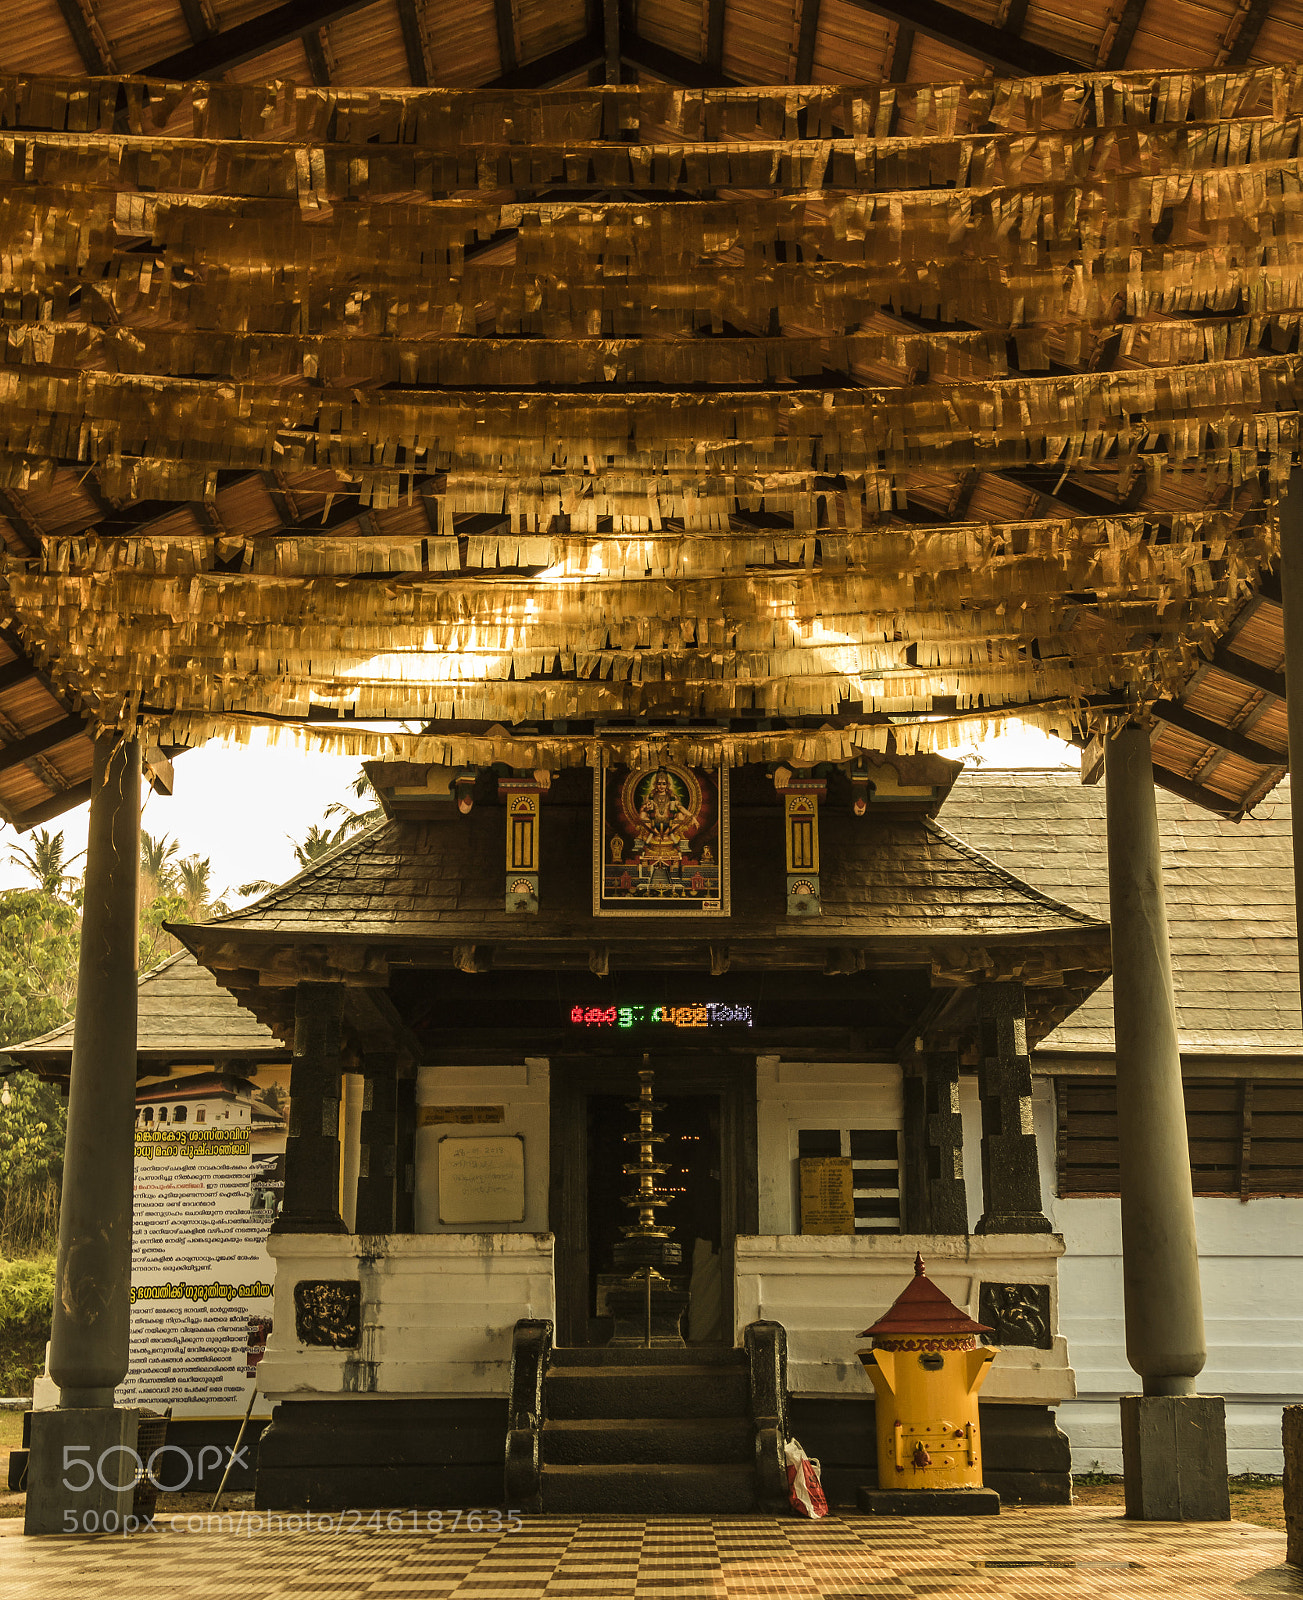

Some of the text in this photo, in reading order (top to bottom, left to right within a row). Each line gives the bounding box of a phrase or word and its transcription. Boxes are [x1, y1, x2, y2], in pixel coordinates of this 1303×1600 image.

[188, 1127, 251, 1142] ശാസ്താവിന്
[154, 1144, 178, 1157] മഹാ
[179, 1142, 250, 1159] പുഷ്പാഞ്ജലി
[137, 1282, 185, 1300] ഭഗവതിക്ക്
[185, 1281, 237, 1302] ഗുരുതിയും
[238, 1281, 270, 1298] ചെറിയ
